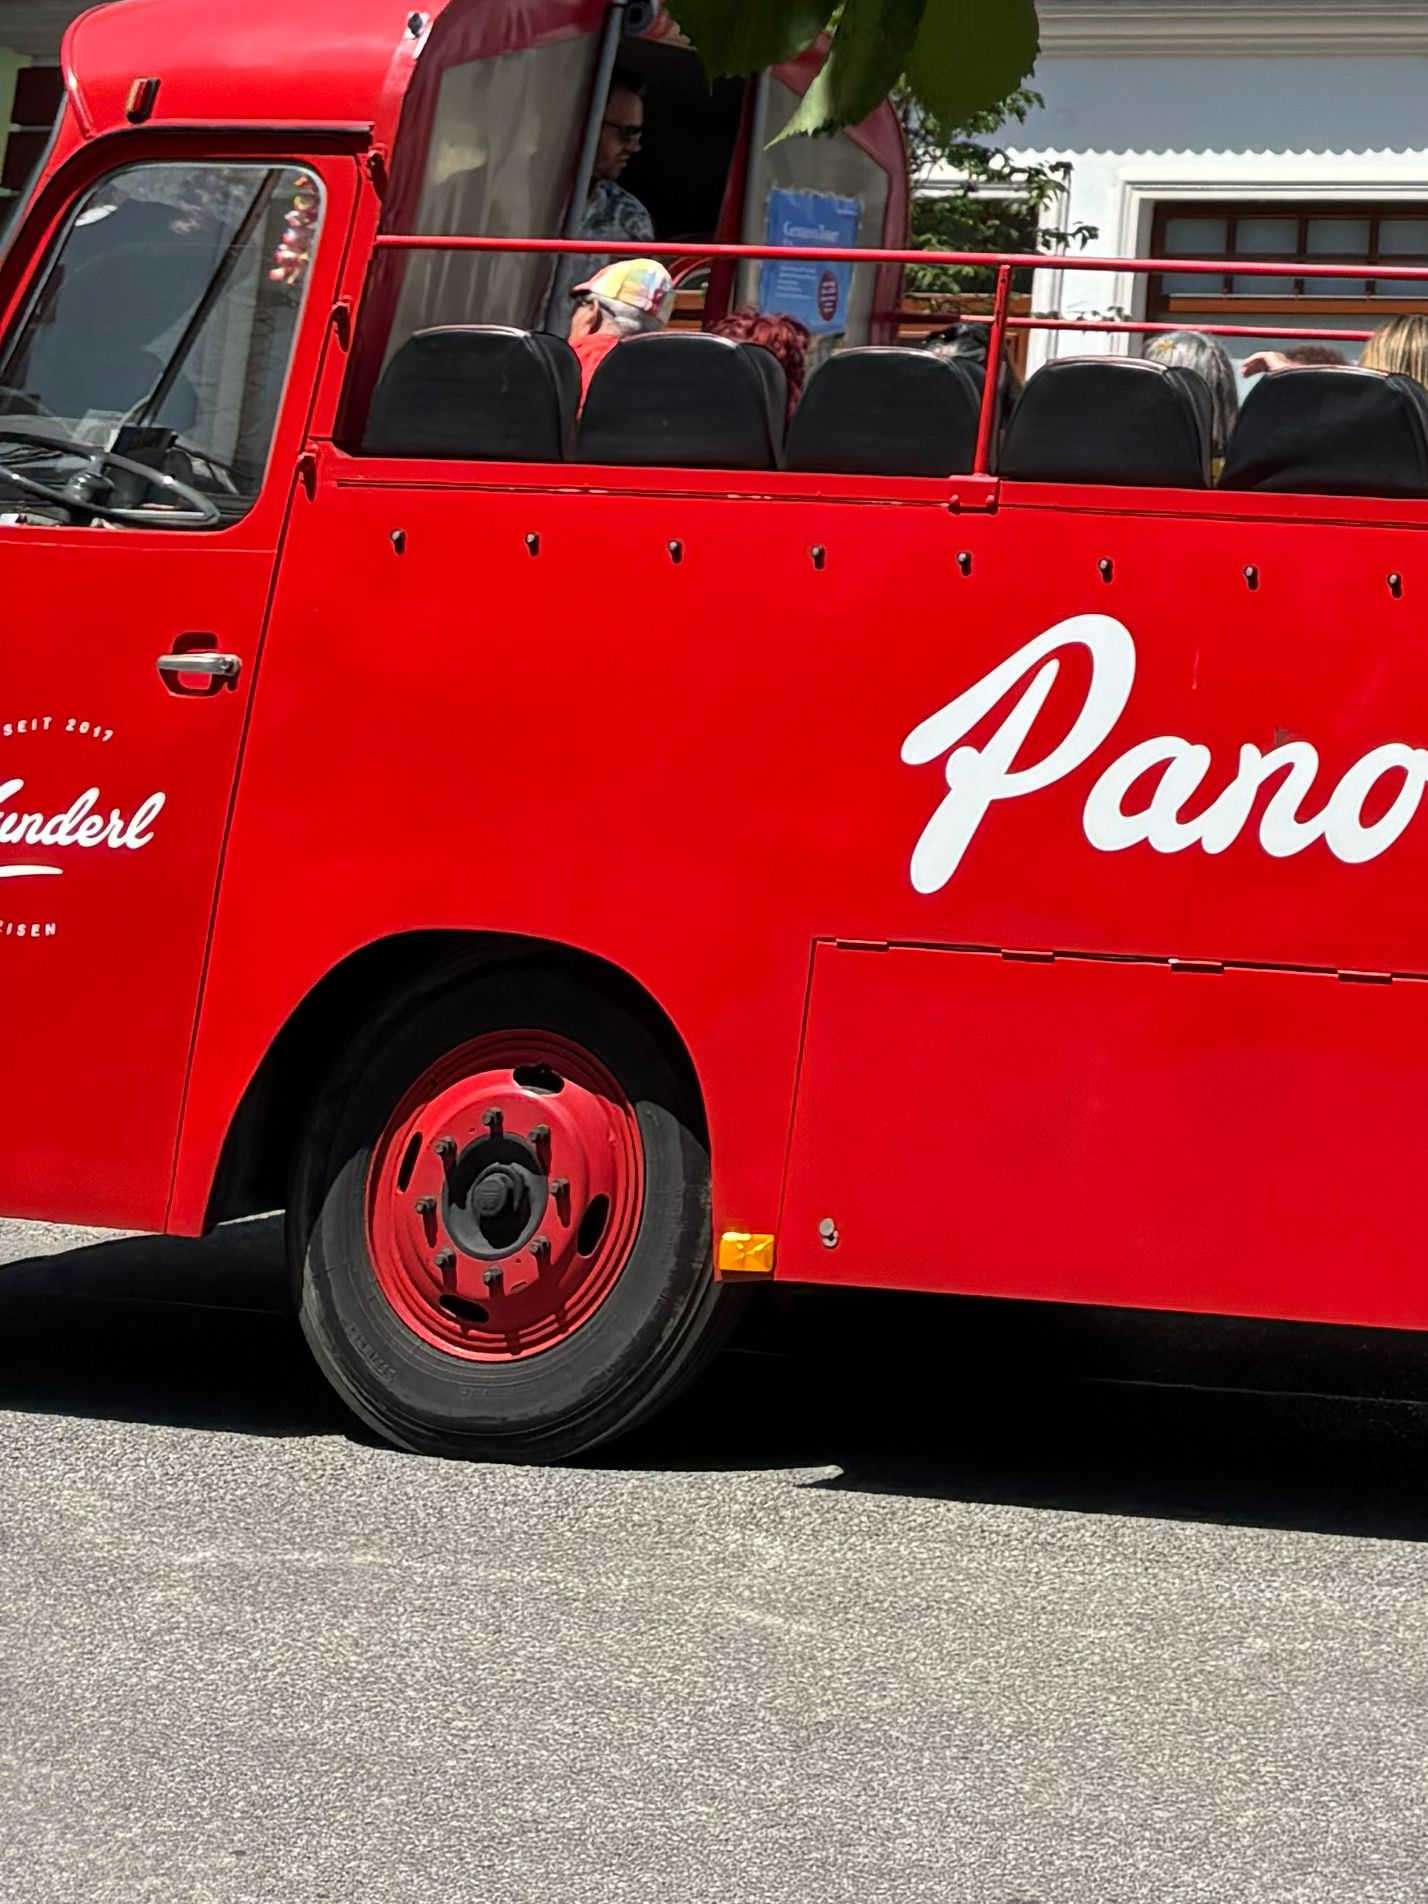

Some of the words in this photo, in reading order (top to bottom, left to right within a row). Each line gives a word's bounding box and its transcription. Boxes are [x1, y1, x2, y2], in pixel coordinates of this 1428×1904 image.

[3, 717, 52, 736] SEIT
[66, 718, 114, 742] 2017
[0, 920, 56, 937] ISEN
